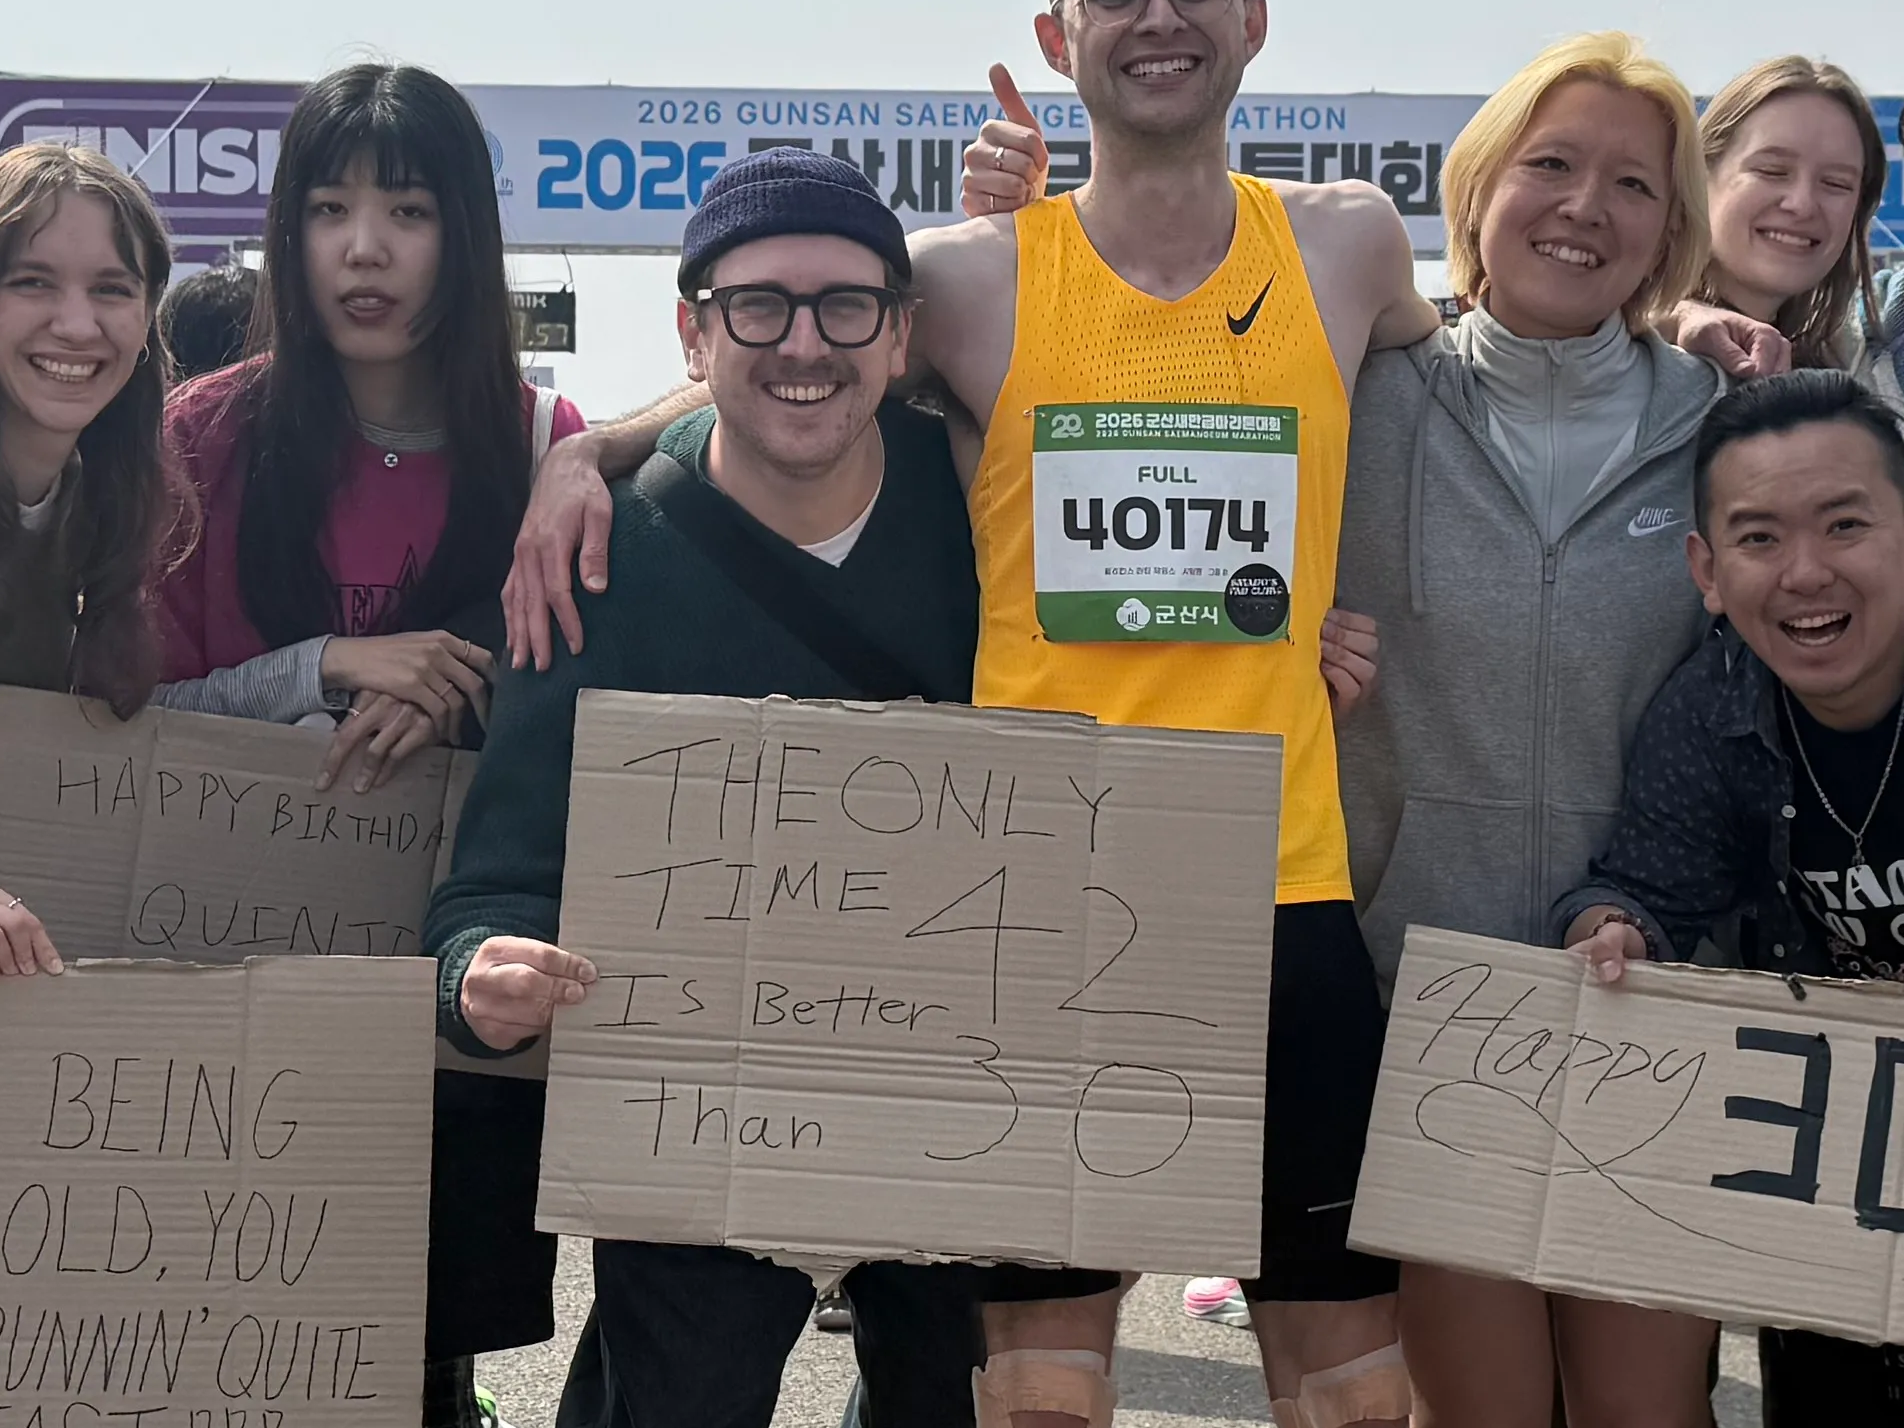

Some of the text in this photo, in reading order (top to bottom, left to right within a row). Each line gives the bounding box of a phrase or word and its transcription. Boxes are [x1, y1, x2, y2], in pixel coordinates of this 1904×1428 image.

[638, 100, 722, 125] 2026
[737, 102, 880, 126] GUNSAN
[537, 139, 727, 210] 2026
[1096, 413, 1143, 429] 2026
[1138, 466, 1197, 483] FULL
[1062, 496, 1269, 552] 40174
[1637, 507, 1674, 526] NIKE
[1155, 605, 1218, 625] 군산시
[57, 757, 448, 854] HAPPY BIRTHDA
[623, 738, 1113, 854] THE ONLY
[614, 857, 1220, 1027] TIME 42
[751, 980, 950, 1033] Better
[1417, 963, 1708, 1147] Happy
[43, 1051, 301, 1161] BEING
[924, 1034, 1194, 1179] 30
[202, 1188, 329, 1286] YOU
[215, 1313, 381, 1401] QUITE
